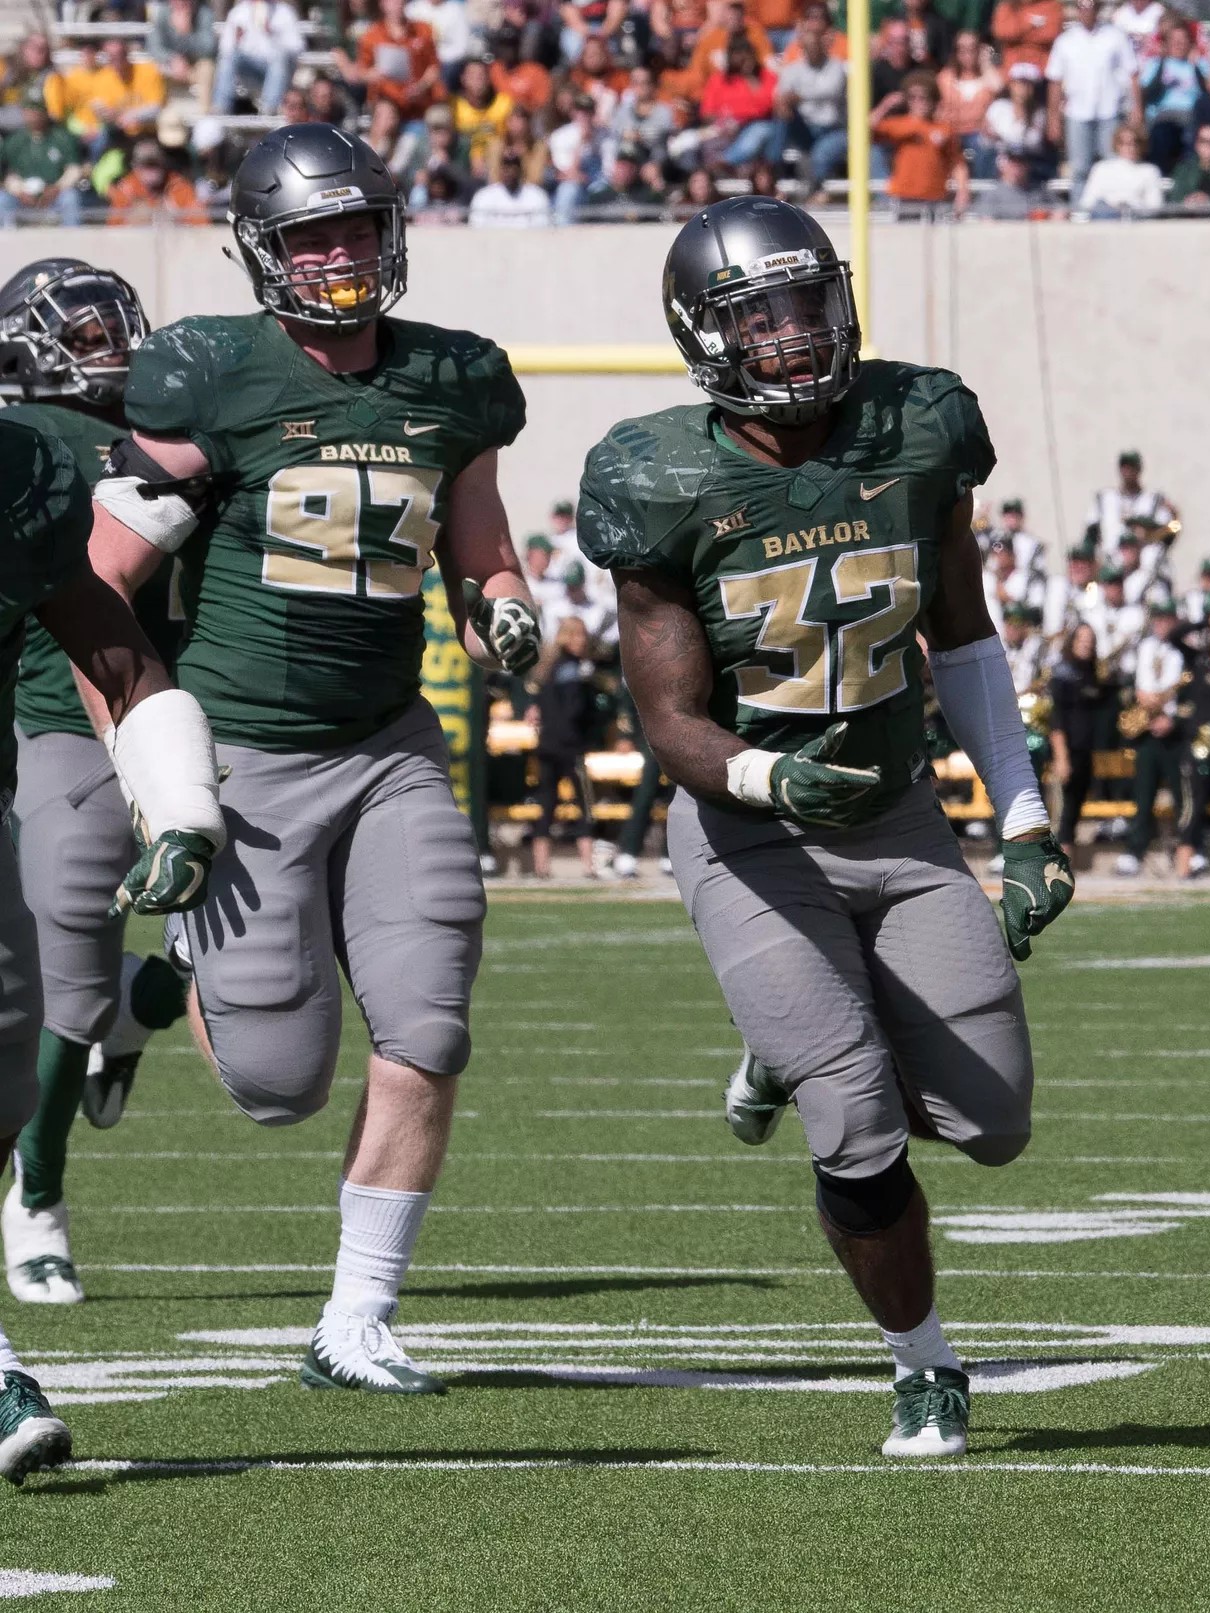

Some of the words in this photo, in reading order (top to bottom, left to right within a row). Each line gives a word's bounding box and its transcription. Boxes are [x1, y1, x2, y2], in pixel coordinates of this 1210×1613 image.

[717, 269, 732, 281] NIKE
[764, 255, 799, 269] BAYLOR
[320, 443, 413, 464] BAYLOR
[262, 464, 444, 598] 93
[762, 520, 871, 560] BAYLOR
[717, 541, 922, 714] 32
